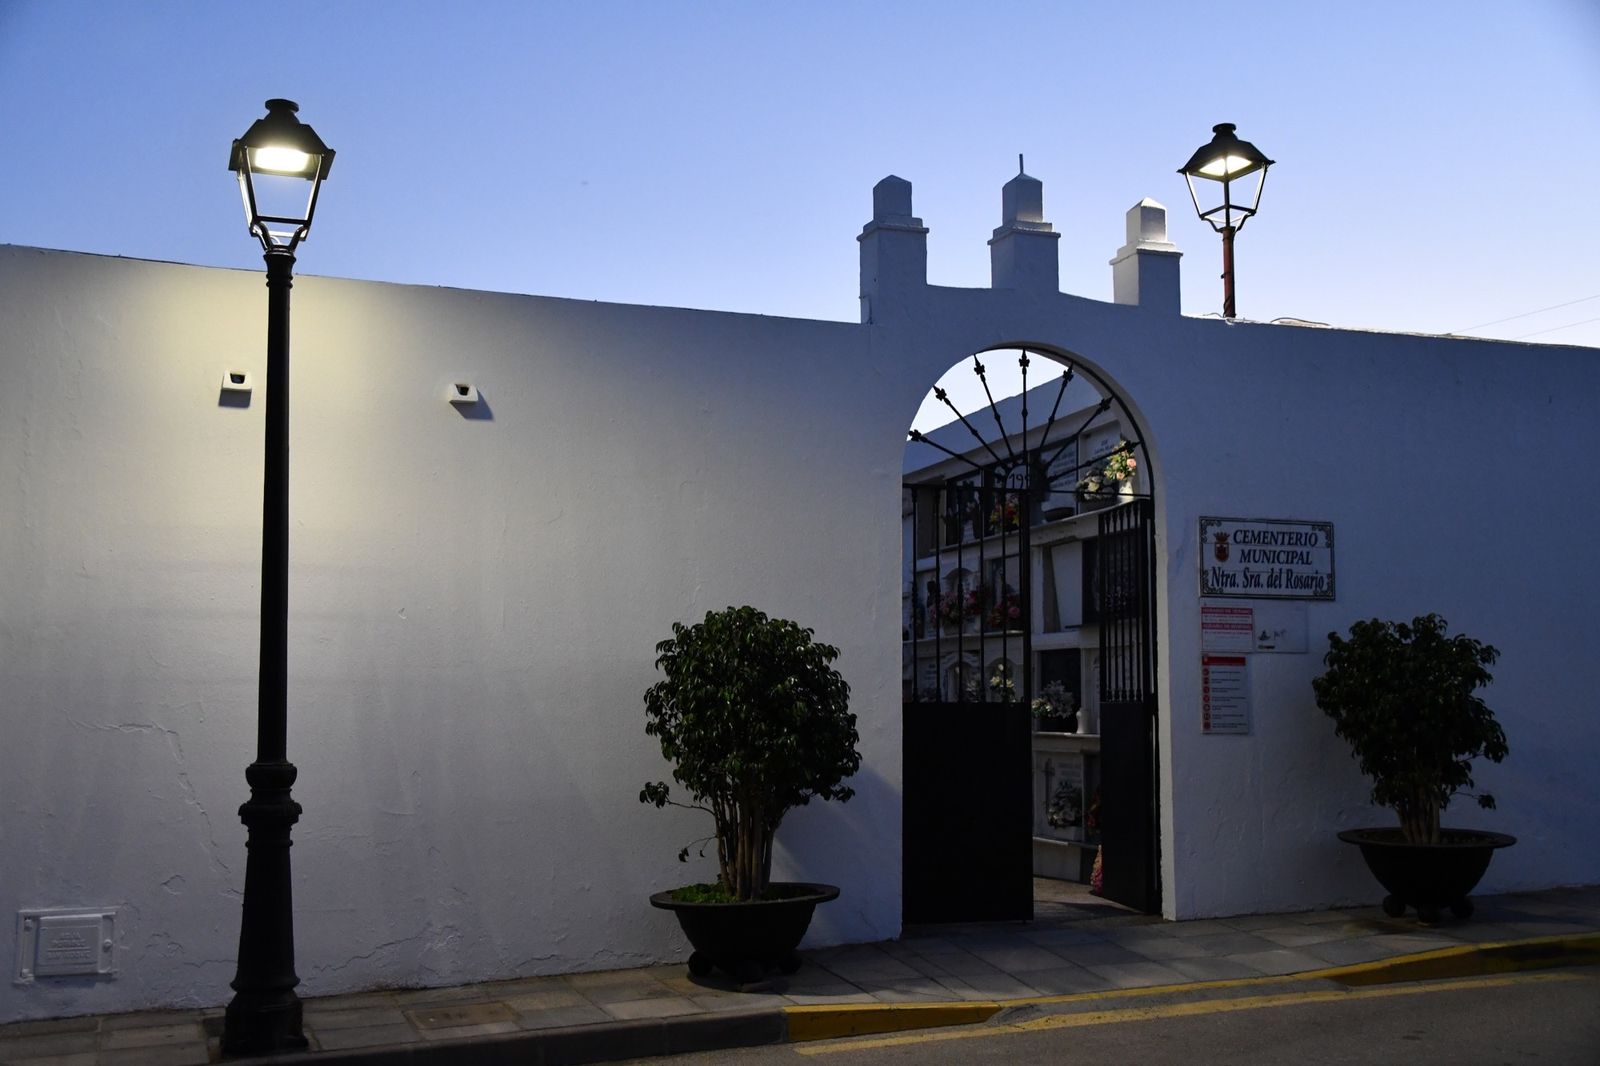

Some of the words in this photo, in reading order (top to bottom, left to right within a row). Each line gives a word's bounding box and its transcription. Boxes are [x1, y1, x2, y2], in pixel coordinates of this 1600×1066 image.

[1233, 529, 1318, 547] CEMENTERIO
[1239, 549, 1312, 565] MUNICIPAL
[1211, 566, 1239, 588] Ntra.
[1243, 567, 1264, 588] Sra.
[1267, 568, 1282, 589] del
[1286, 568, 1324, 590] Rosario
